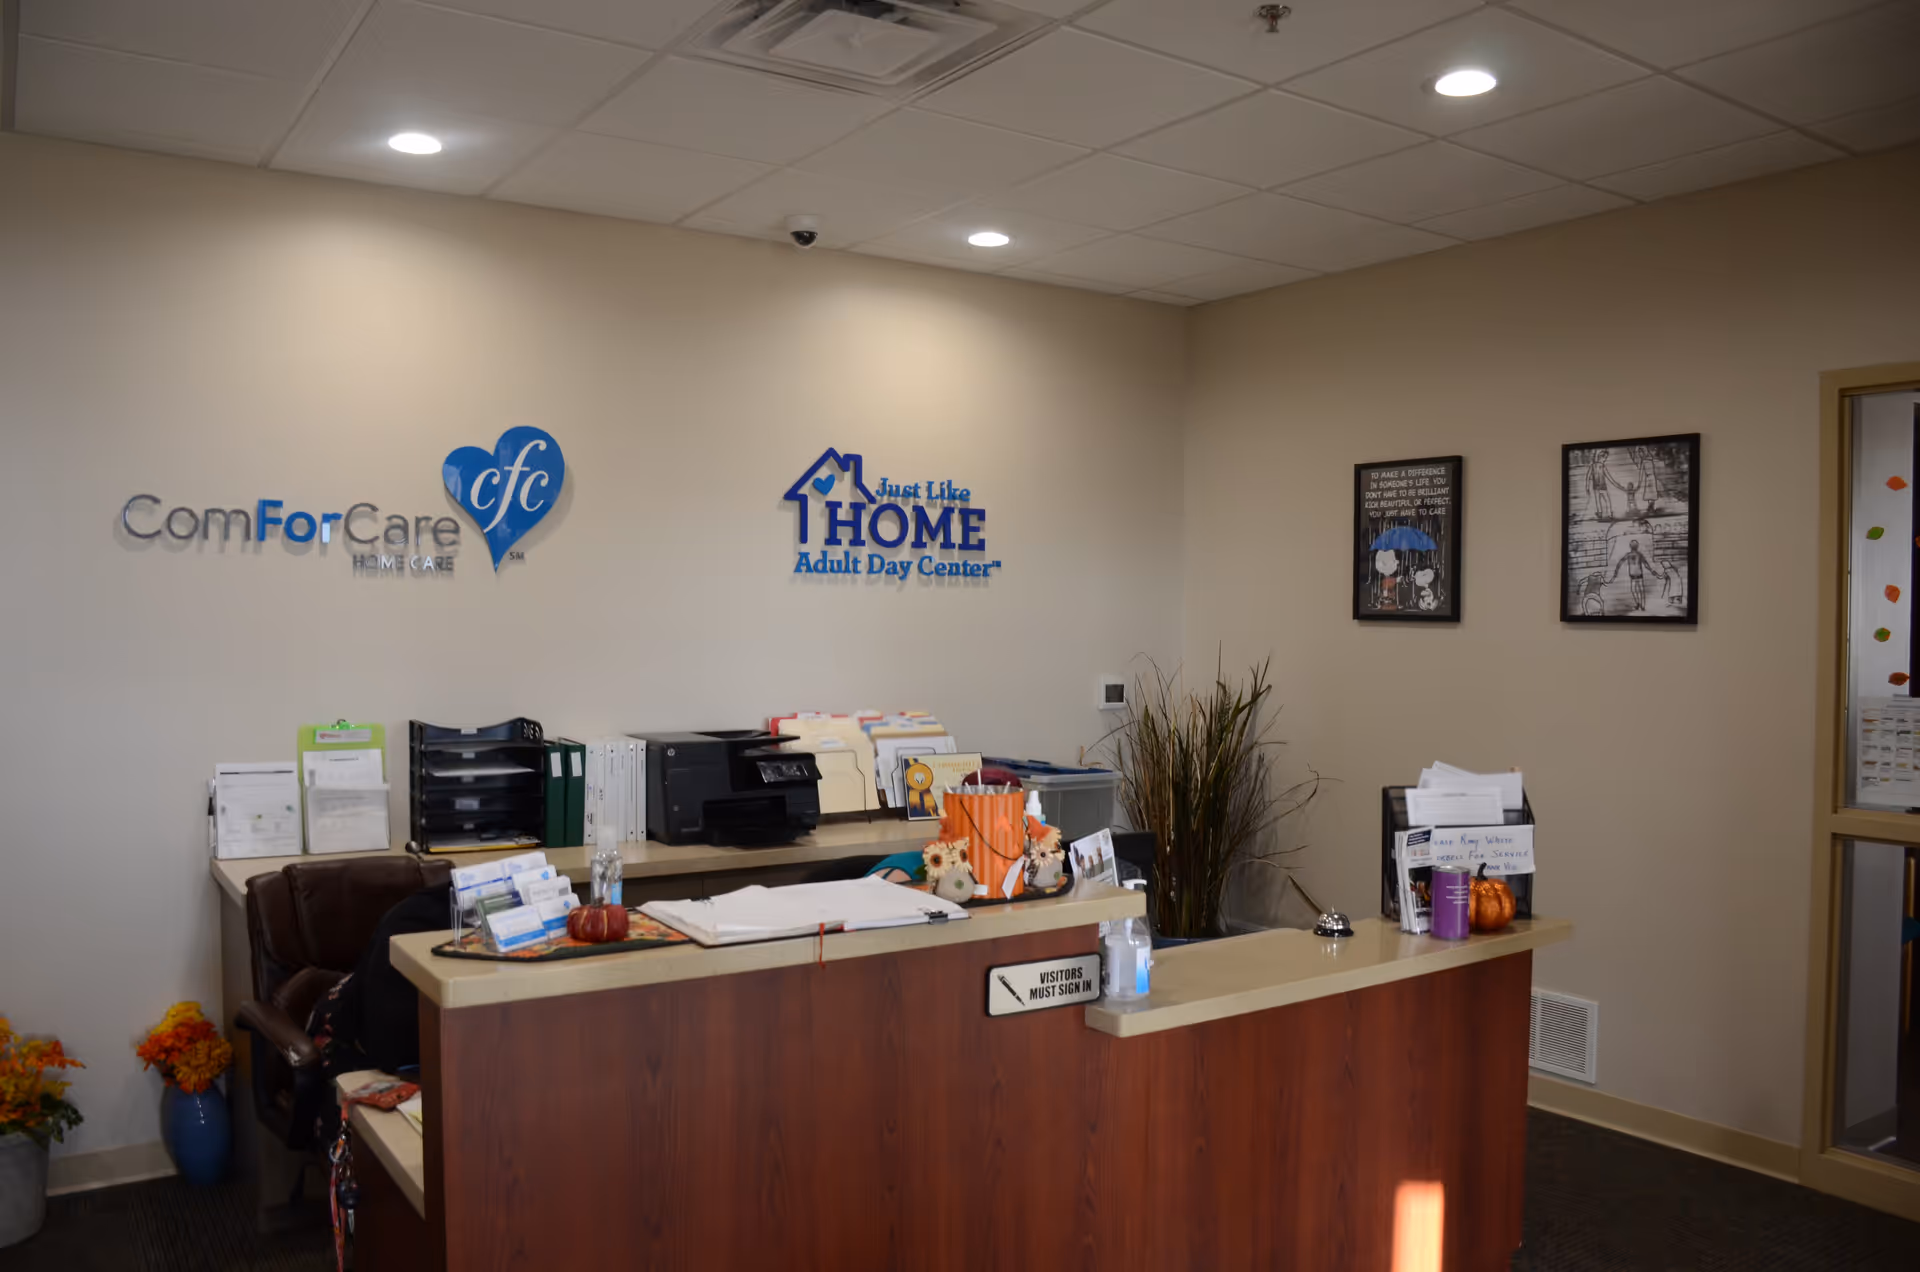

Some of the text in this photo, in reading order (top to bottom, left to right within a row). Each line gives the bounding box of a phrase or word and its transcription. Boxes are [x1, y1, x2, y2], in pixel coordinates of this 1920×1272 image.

[1371, 472, 1379, 480] TO
[1381, 471, 1399, 479] MAKE
[1408, 467, 1446, 477] DIFFERENCE
[1379, 480, 1414, 489] SOMEONE'S
[1416, 478, 1429, 486] LIFE
[1433, 477, 1446, 485] YOU
[470, 439, 549, 535] cfc
[875, 478, 971, 502] Just Like
[1383, 490, 1398, 498] HAVE
[1399, 489, 1407, 497] TO
[122, 493, 460, 546] ComForCare
[1369, 510, 1382, 518] YOU
[1400, 508, 1416, 517] HAVE
[1429, 507, 1446, 515] CARE
[825, 501, 986, 552] HOME
[353, 554, 454, 571] HOME CARE
[793, 551, 862, 574] Adult
[867, 554, 913, 580] Day
[1039, 967, 1083, 984] VISITORS
[1029, 979, 1092, 1000] MUST SIGN IN
